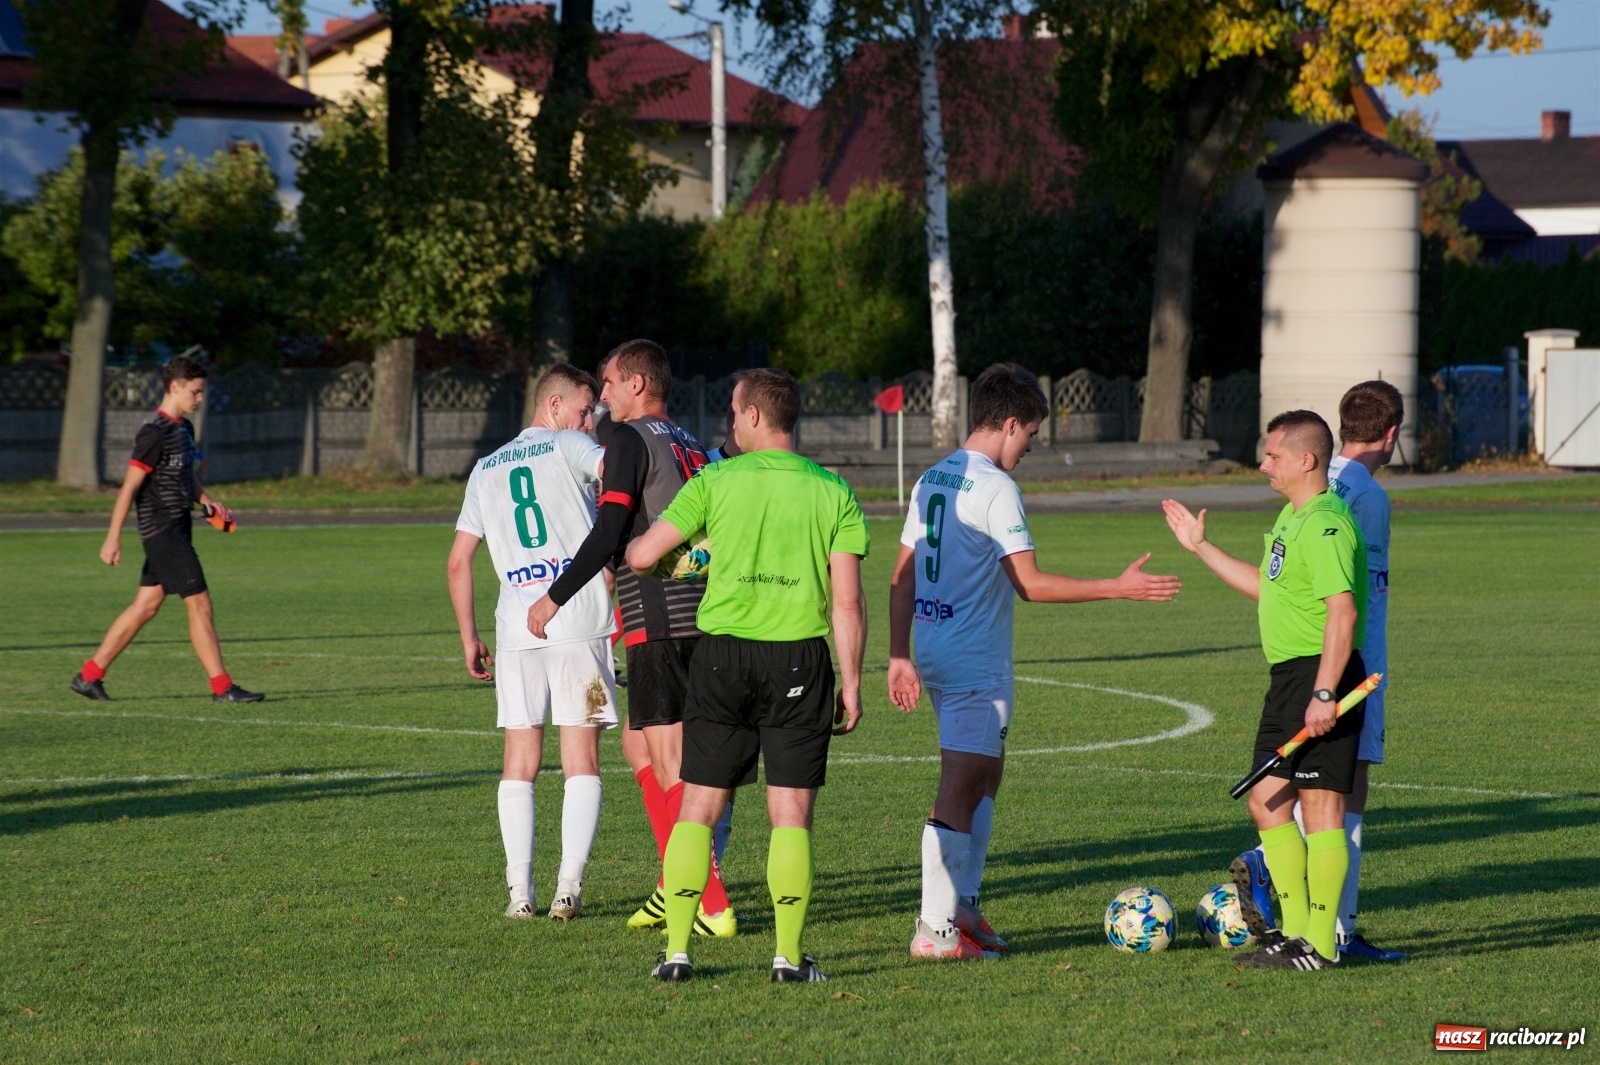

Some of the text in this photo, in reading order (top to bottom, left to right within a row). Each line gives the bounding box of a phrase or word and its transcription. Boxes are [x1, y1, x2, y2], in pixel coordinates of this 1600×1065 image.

[646, 421, 670, 435] LKS
[509, 466, 548, 548] 8
[925, 493, 946, 584] 9
